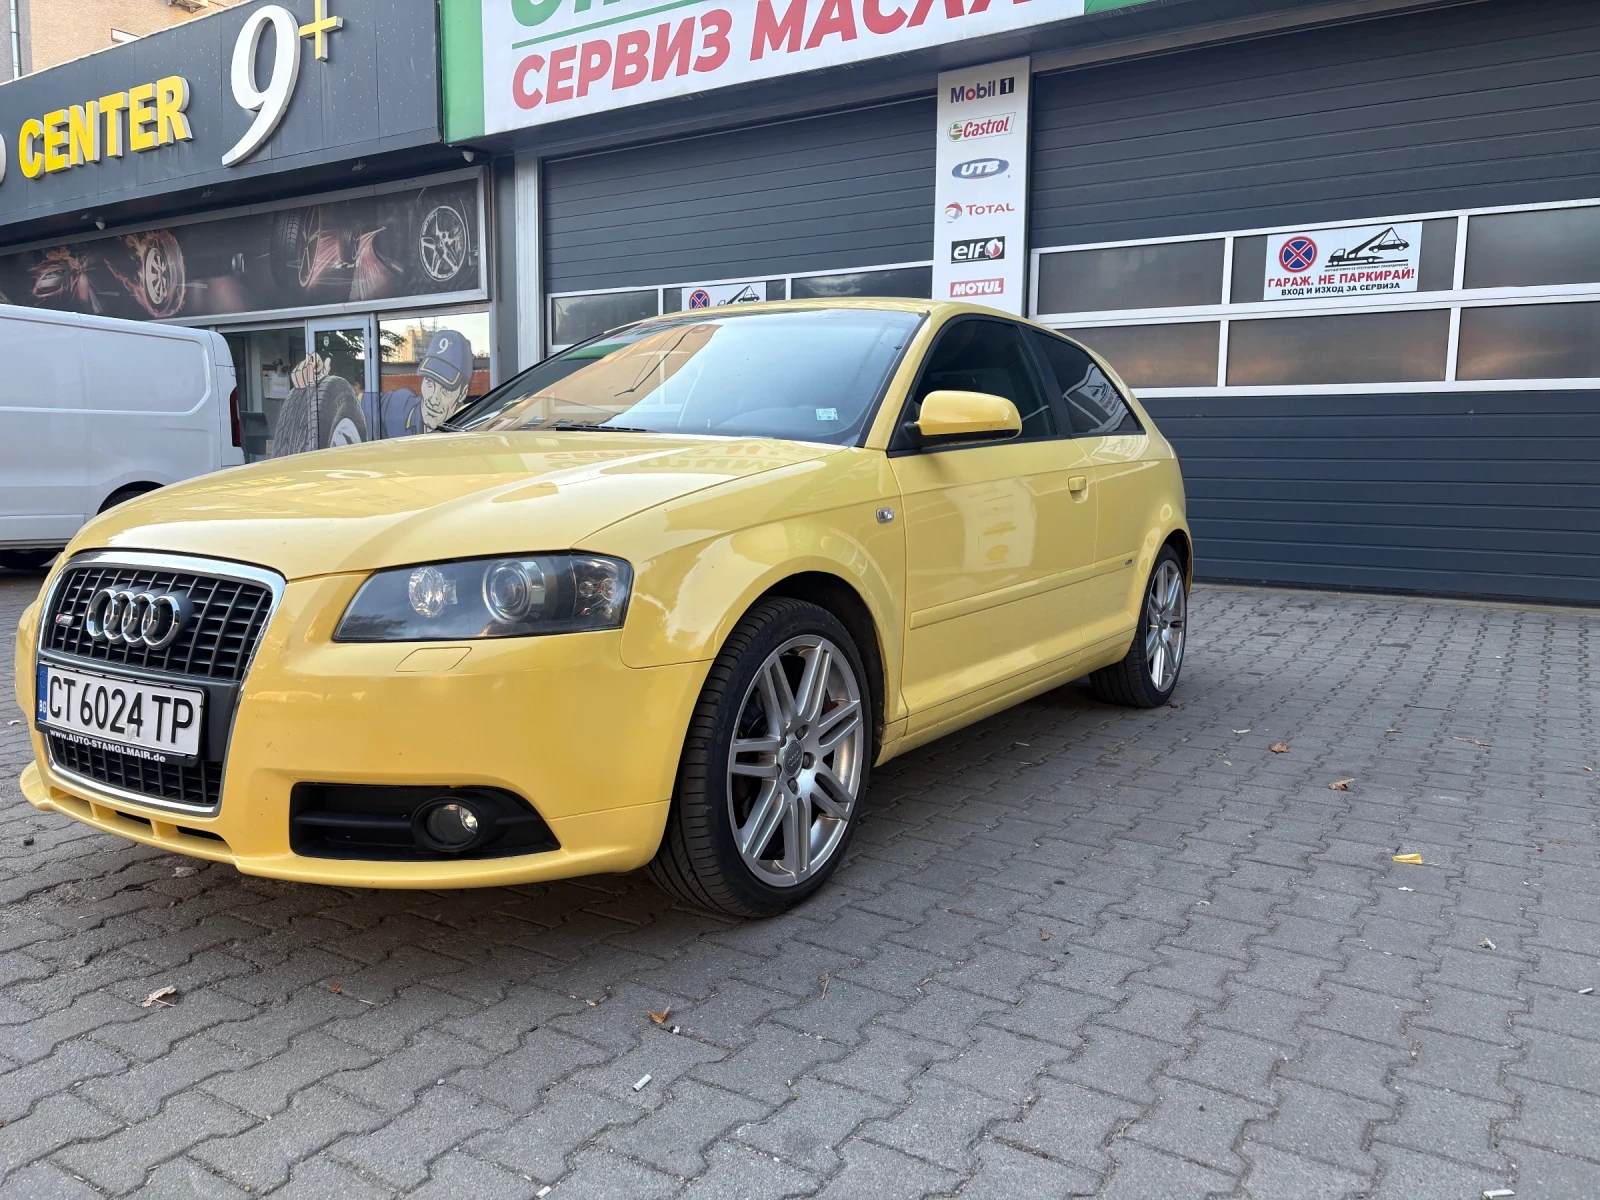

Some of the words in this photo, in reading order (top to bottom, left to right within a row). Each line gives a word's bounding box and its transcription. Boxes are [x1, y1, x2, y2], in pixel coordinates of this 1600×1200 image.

[512, 8, 733, 110] СЕРВИЗ
[749, 0, 1033, 61] МАС
[950, 80, 996, 104] Mobil
[19, 75, 193, 179] CENTER
[963, 116, 1009, 138] Castrol
[960, 160, 1000, 176] UTB
[966, 202, 1015, 216] TOTAL
[953, 241, 985, 260] elf
[952, 280, 1002, 296] MOTUL
[1268, 276, 1314, 288] ГАРАЖ.
[1318, 274, 1335, 285] НЕ
[1338, 267, 1415, 284] ПАРКИРАЙ!
[1281, 288, 1304, 296] ВХОД
[1315, 286, 1344, 295] ИЗХОД
[1360, 282, 1400, 291] СЕРВИЗА
[39, 700, 47, 713] BG
[50, 675, 76, 722] CT
[80, 683, 143, 738] 6024
[152, 694, 194, 744] TP
[50, 729, 166, 763] www.AUTO-STANGLMAIR.de
